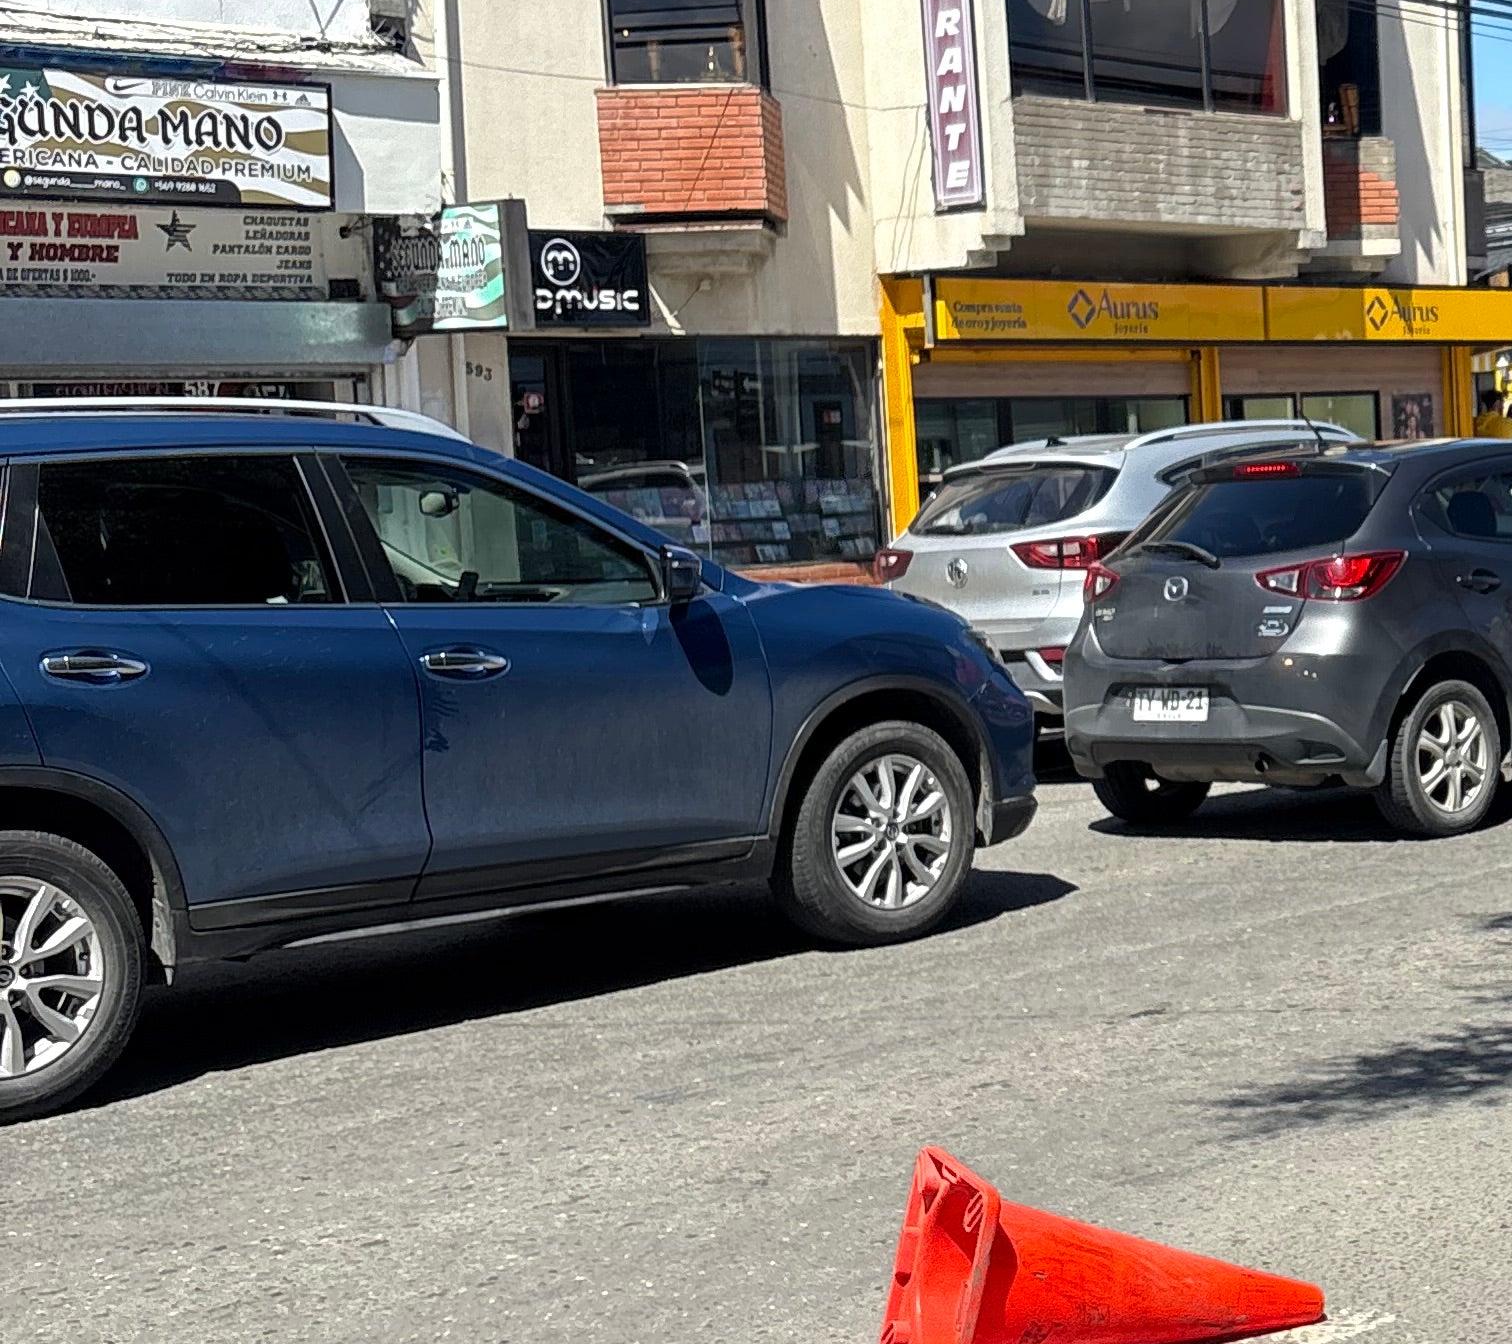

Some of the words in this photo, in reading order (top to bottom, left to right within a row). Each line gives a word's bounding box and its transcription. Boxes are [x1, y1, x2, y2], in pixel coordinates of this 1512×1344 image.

[194, 82, 235, 101] Calvin
[238, 85, 268, 102] Klein
[158, 109, 283, 152] MANO
[121, 154, 214, 175] CALIDAD
[222, 160, 312, 181] PREMIUM
[52, 212, 63, 237] Y
[67, 212, 139, 240] EUROPEA
[243, 215, 309, 227] CHAQUETAS
[245, 228, 310, 241] LEÑADORAS
[7, 241, 23, 262] Y
[29, 242, 120, 264] HOMBRE
[212, 242, 273, 255] PANTALÓN
[276, 244, 311, 255] CARGO
[449, 238, 486, 269] MANO
[276, 259, 312, 270] JEANS
[6, 268, 19, 281] DE
[21, 268, 60, 282] OFERTAS
[166, 273, 197, 283] TODO
[200, 273, 215, 283] EN
[219, 273, 248, 283] ROPA
[251, 273, 313, 285] DEPORTIVA
[1097, 288, 1159, 320] Aurus
[1389, 295, 1440, 323] Aurus
[465, 361, 493, 382] 593
[184, 380, 220, 397] 587
